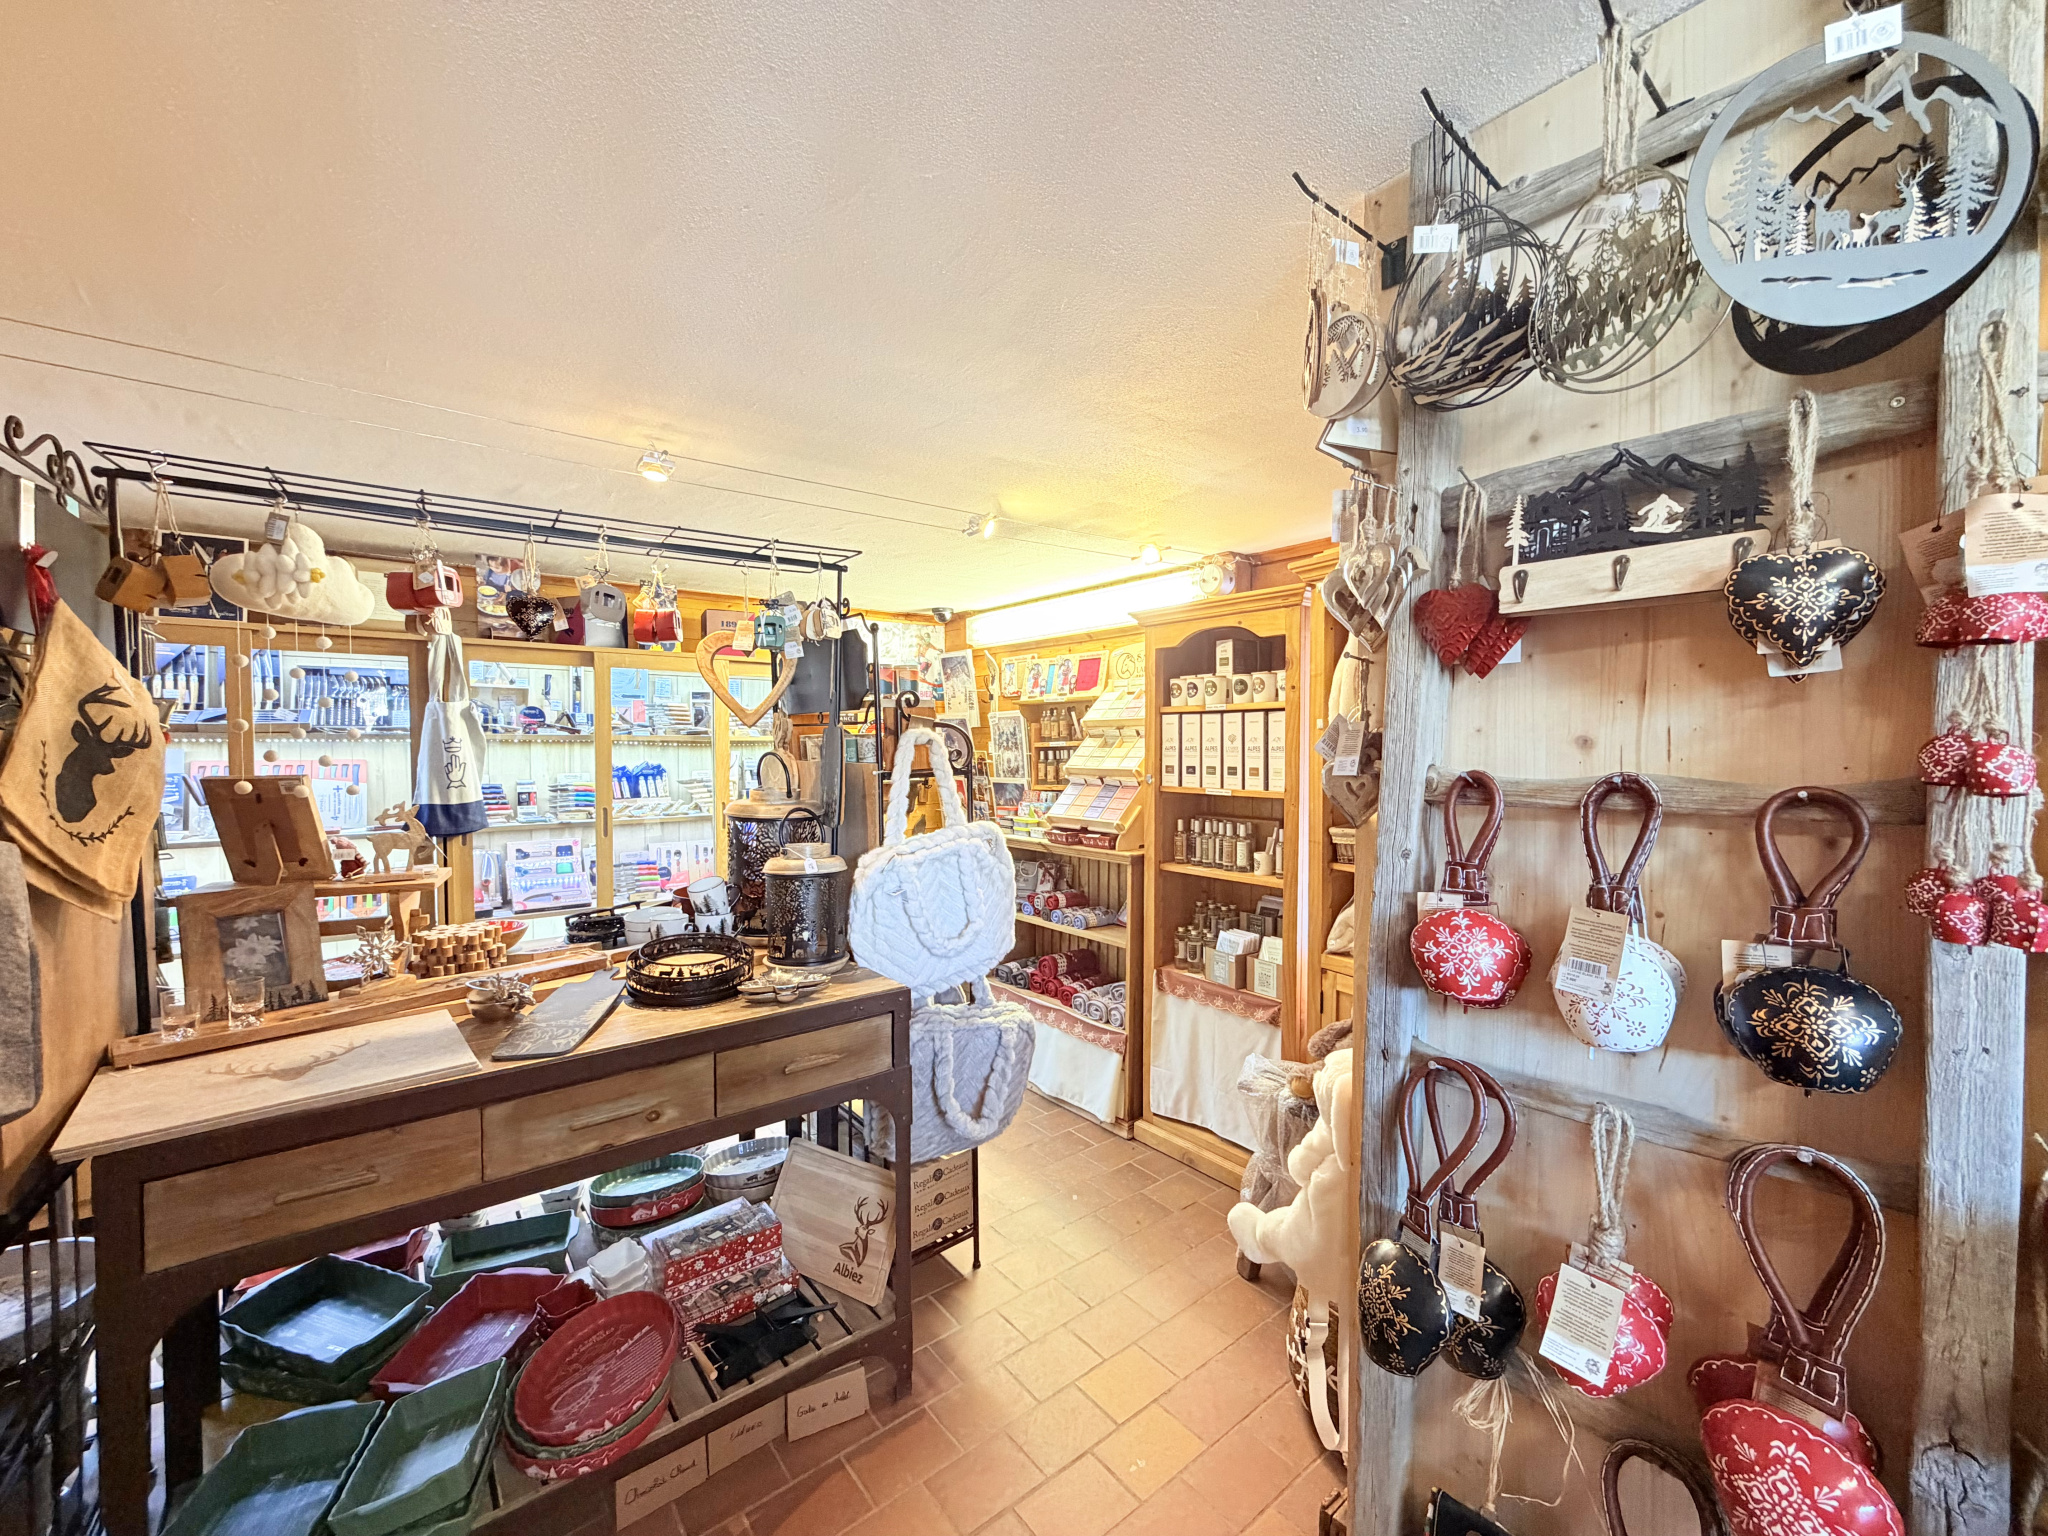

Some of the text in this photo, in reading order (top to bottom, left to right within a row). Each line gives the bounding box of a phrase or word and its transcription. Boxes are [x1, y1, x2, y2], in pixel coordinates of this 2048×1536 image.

[721, 620, 738, 628] 189
[943, 1161, 970, 1176] Cadeaux
[944, 1185, 971, 1200] Cadeaux
[942, 1210, 970, 1225] Cadeaux
[832, 1262, 864, 1285] Albiez
